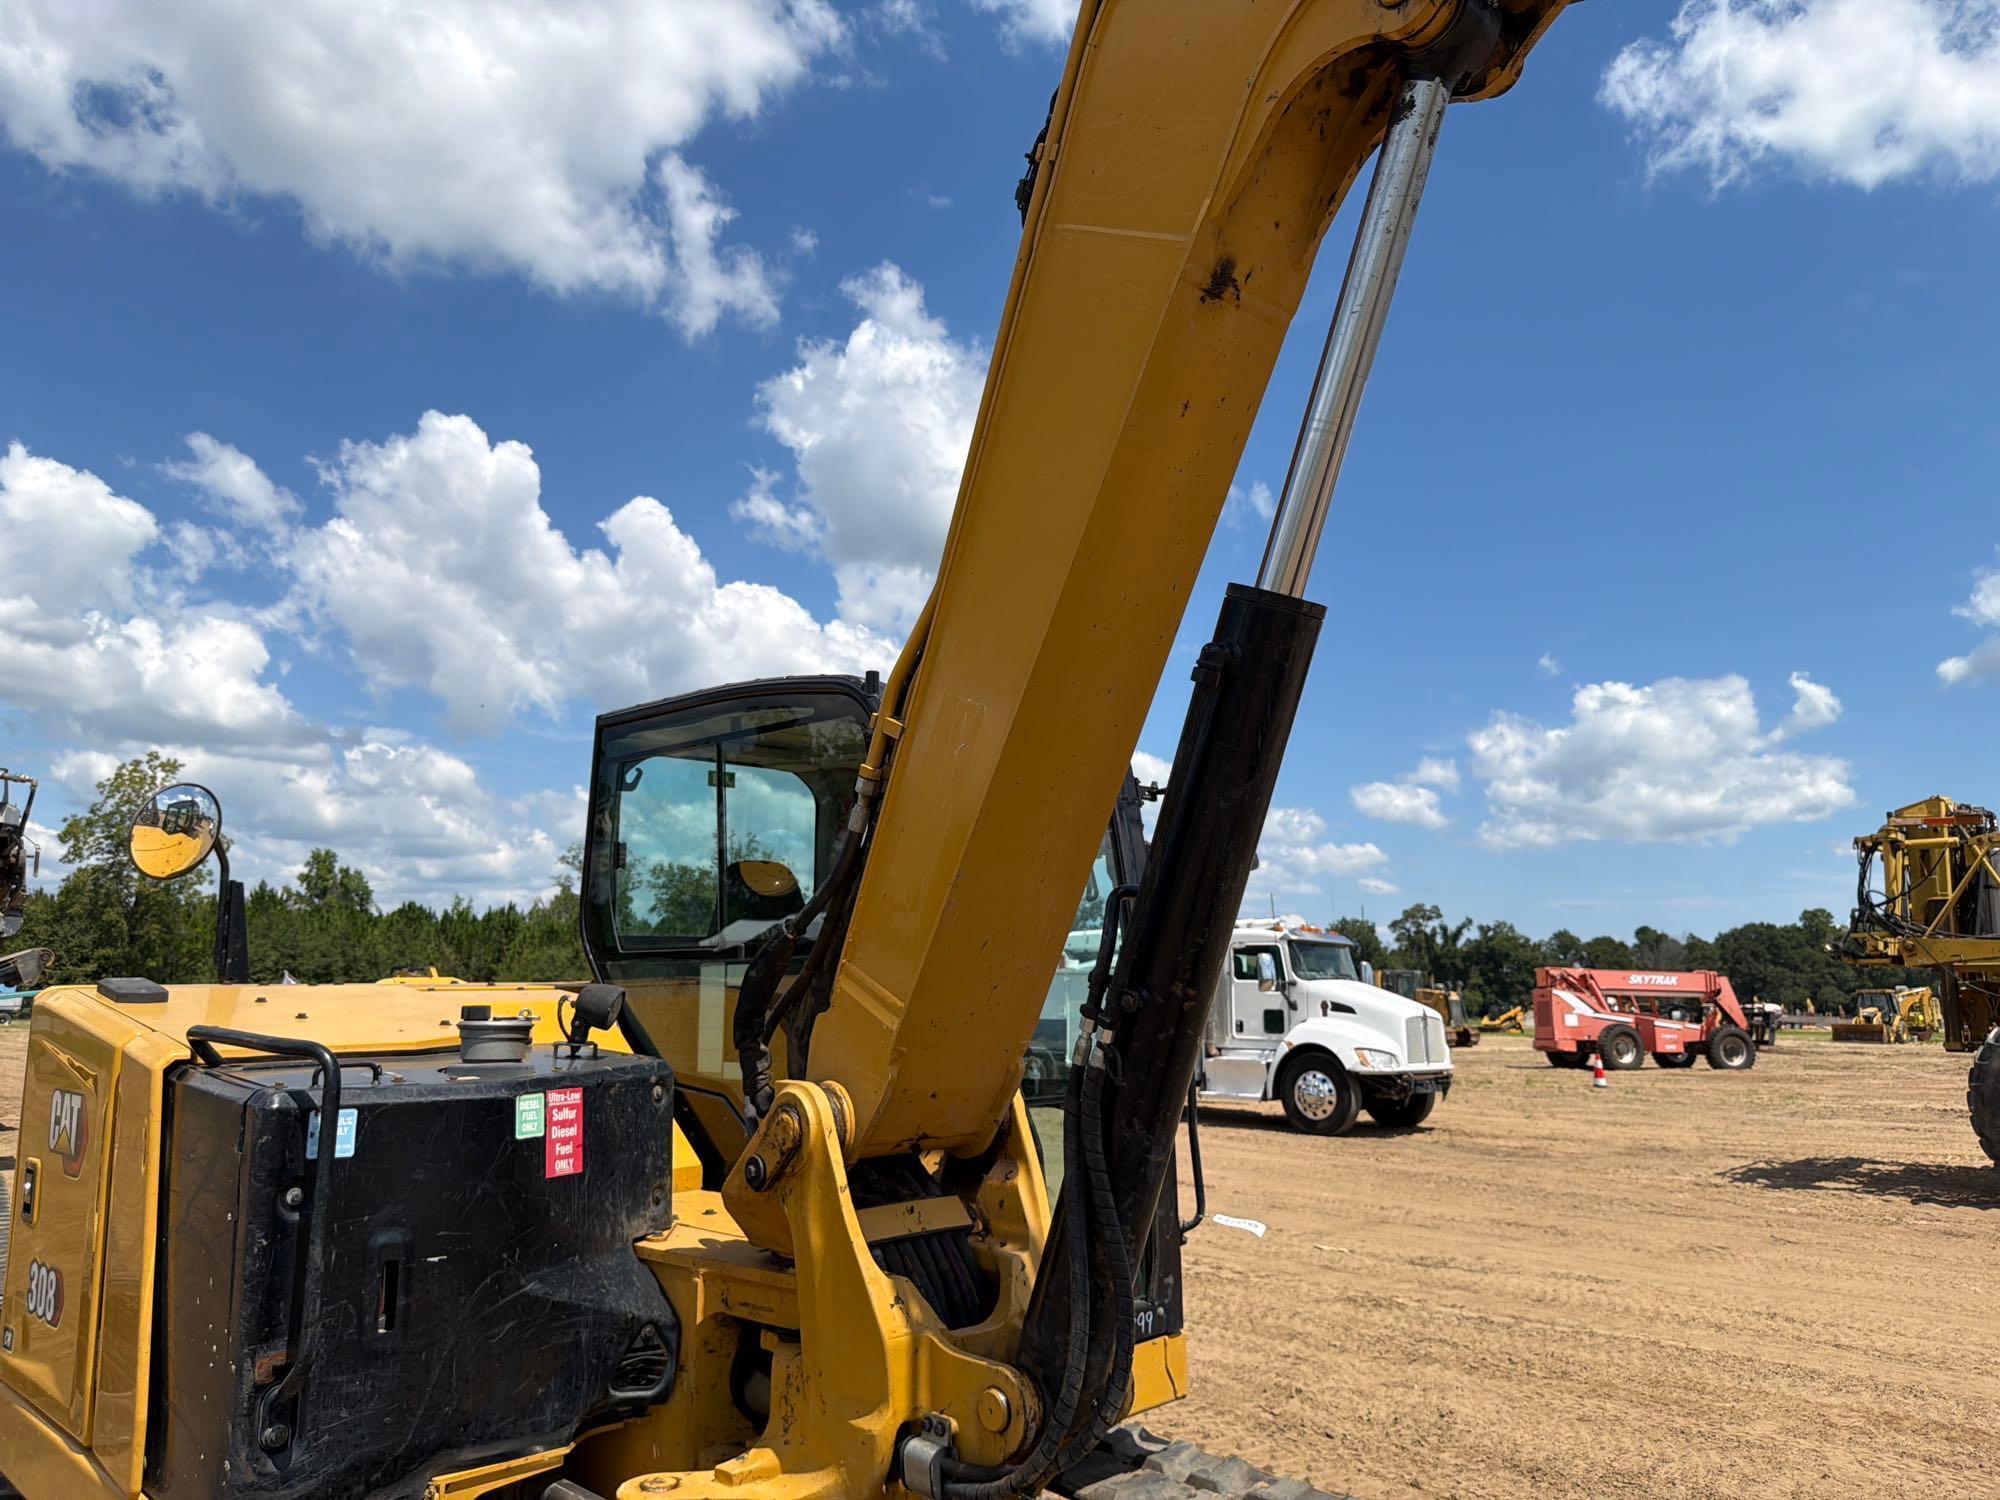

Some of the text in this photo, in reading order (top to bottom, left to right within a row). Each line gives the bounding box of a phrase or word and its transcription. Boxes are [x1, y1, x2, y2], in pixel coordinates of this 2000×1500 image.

[1628, 974, 1678, 985] SKYTRAK
[549, 1091, 581, 1103] Ultra-Low
[520, 1100, 540, 1110] DIESEL
[522, 1112, 538, 1121] FUEL
[552, 1107, 577, 1122] Sulfur
[49, 1089, 82, 1156] CAT
[521, 1123, 538, 1132] ONLY
[551, 1124, 577, 1139] Diesel
[555, 1141, 573, 1156] Fuel
[555, 1158, 574, 1171] ONLY
[28, 1261, 56, 1321] 308
[1134, 1311, 1153, 1335] 99
